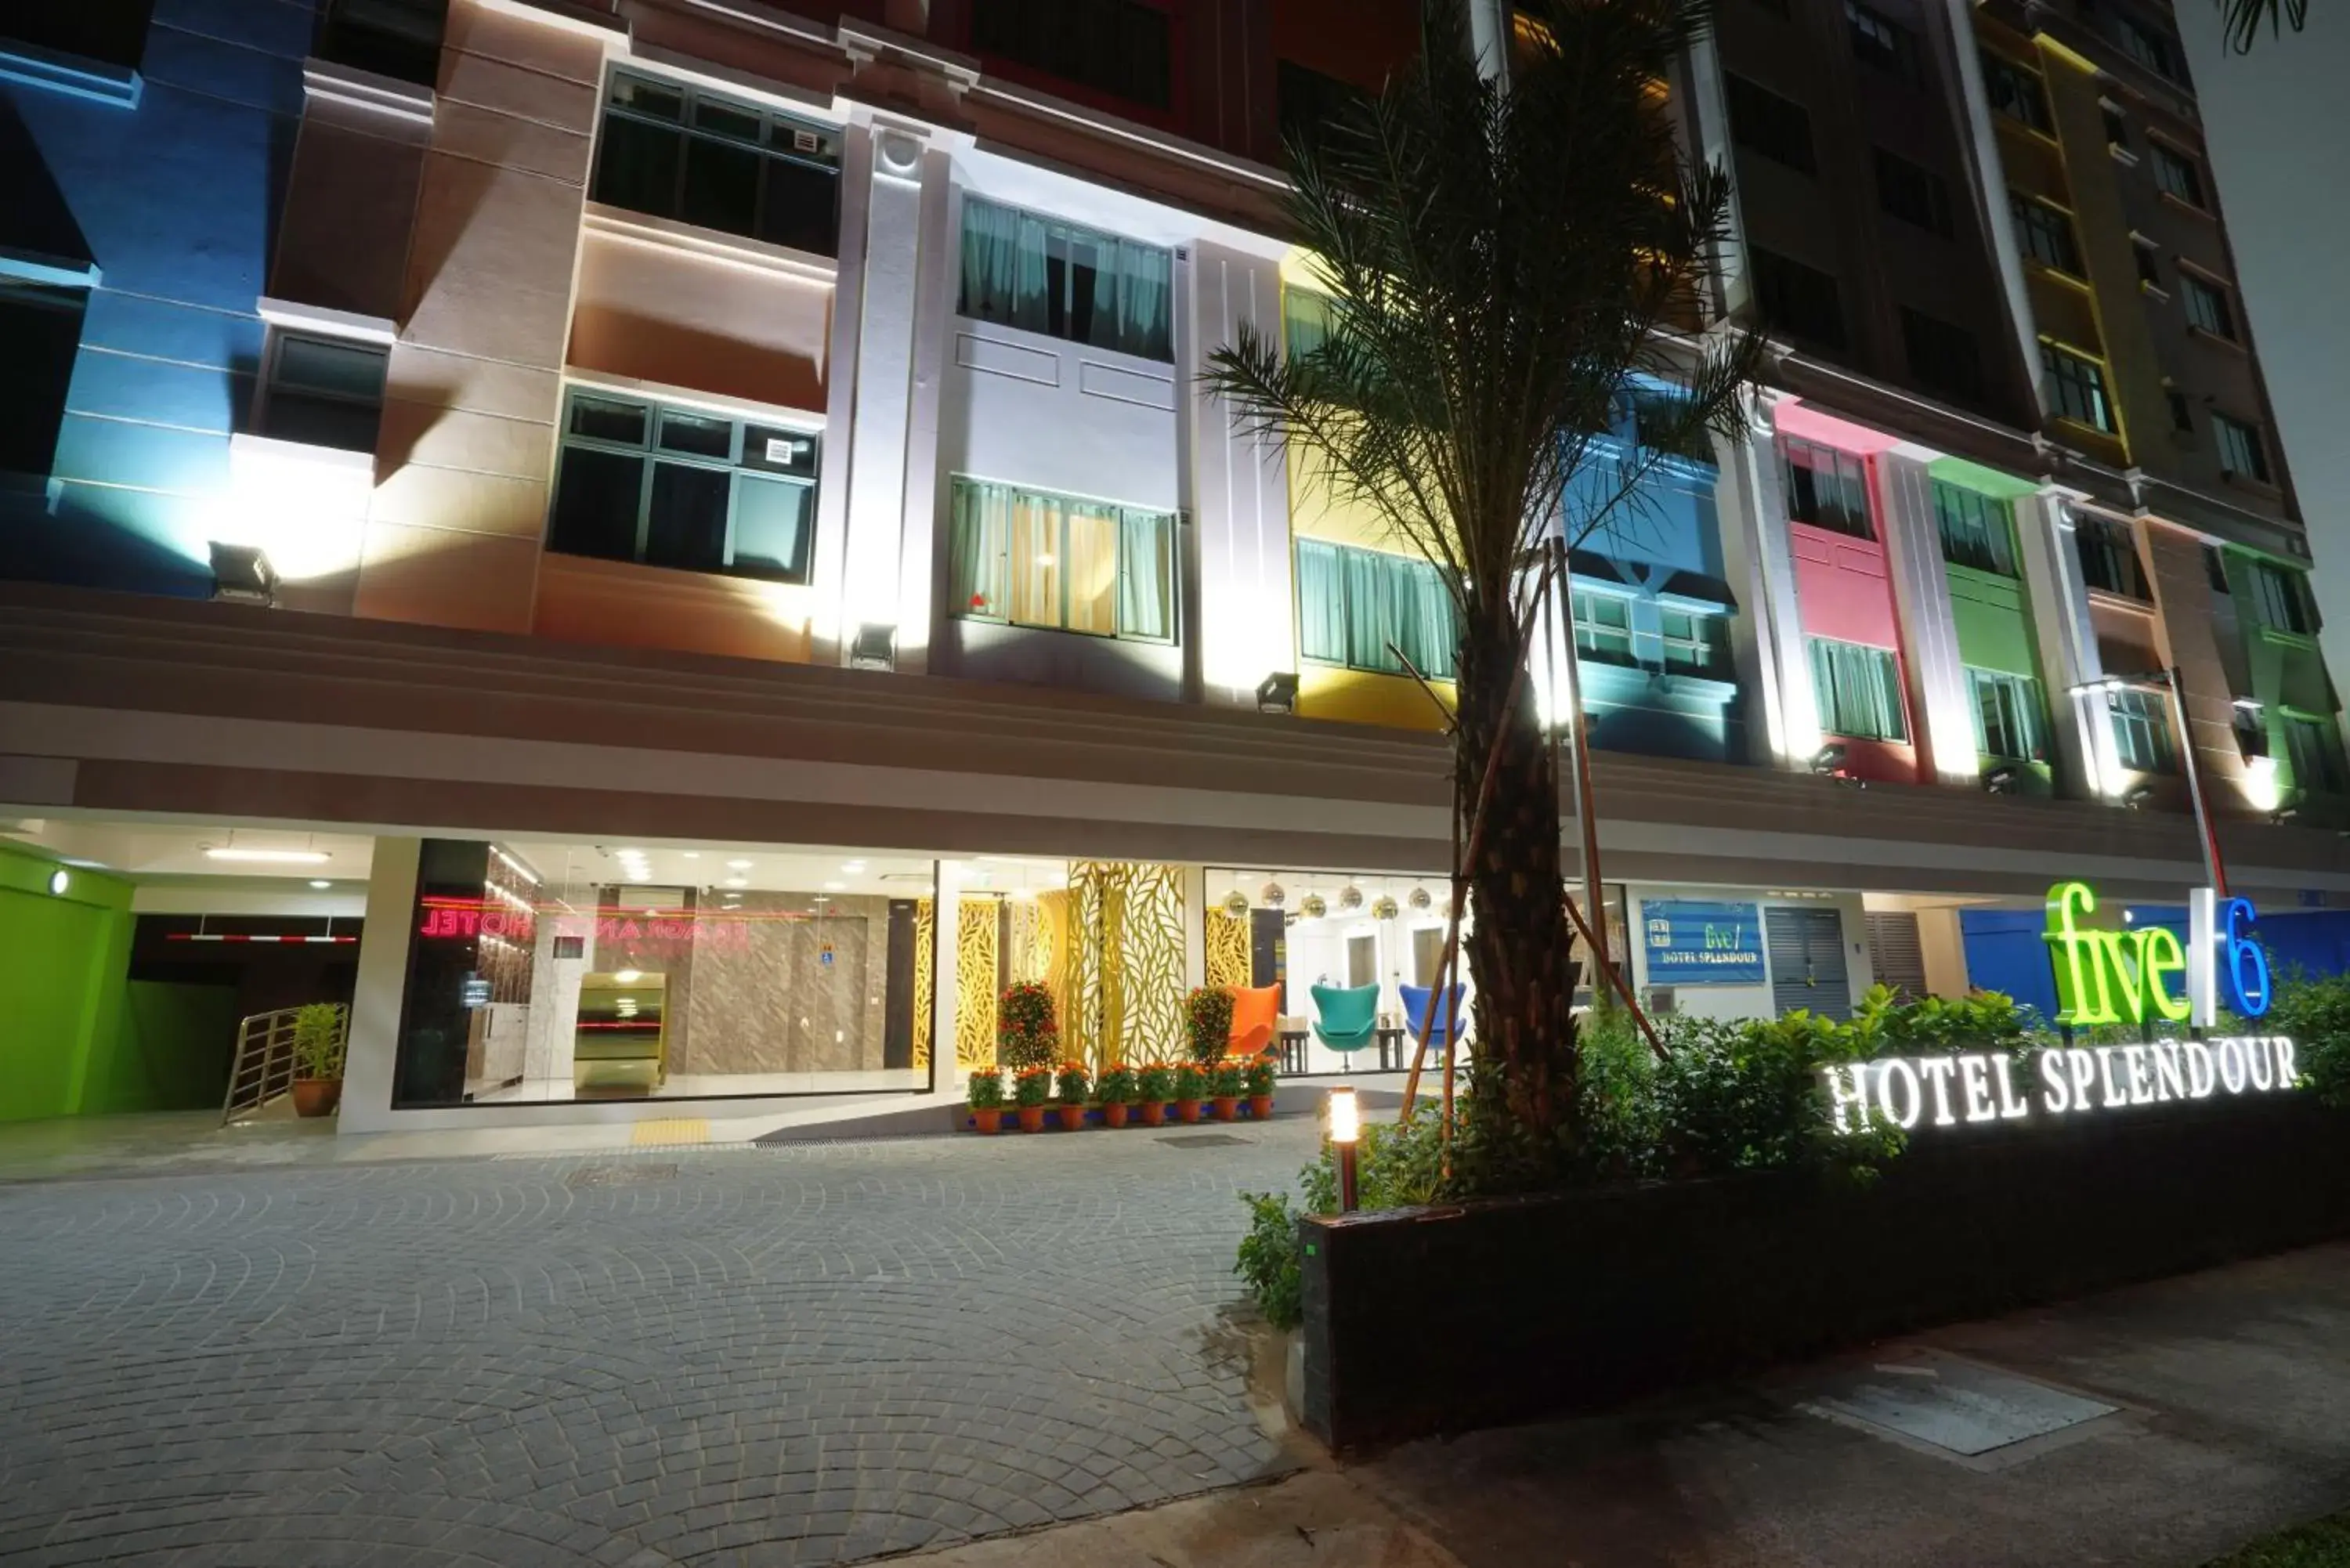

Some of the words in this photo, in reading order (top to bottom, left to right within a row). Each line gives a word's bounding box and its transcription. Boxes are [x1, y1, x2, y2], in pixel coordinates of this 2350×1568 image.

[1661, 951, 1697, 964] HOTEL
[1698, 951, 1758, 964] SPLENDOUR
[1824, 1053, 2028, 1136] HOTEL
[2040, 1035, 2298, 1113] SPLENDOUR
